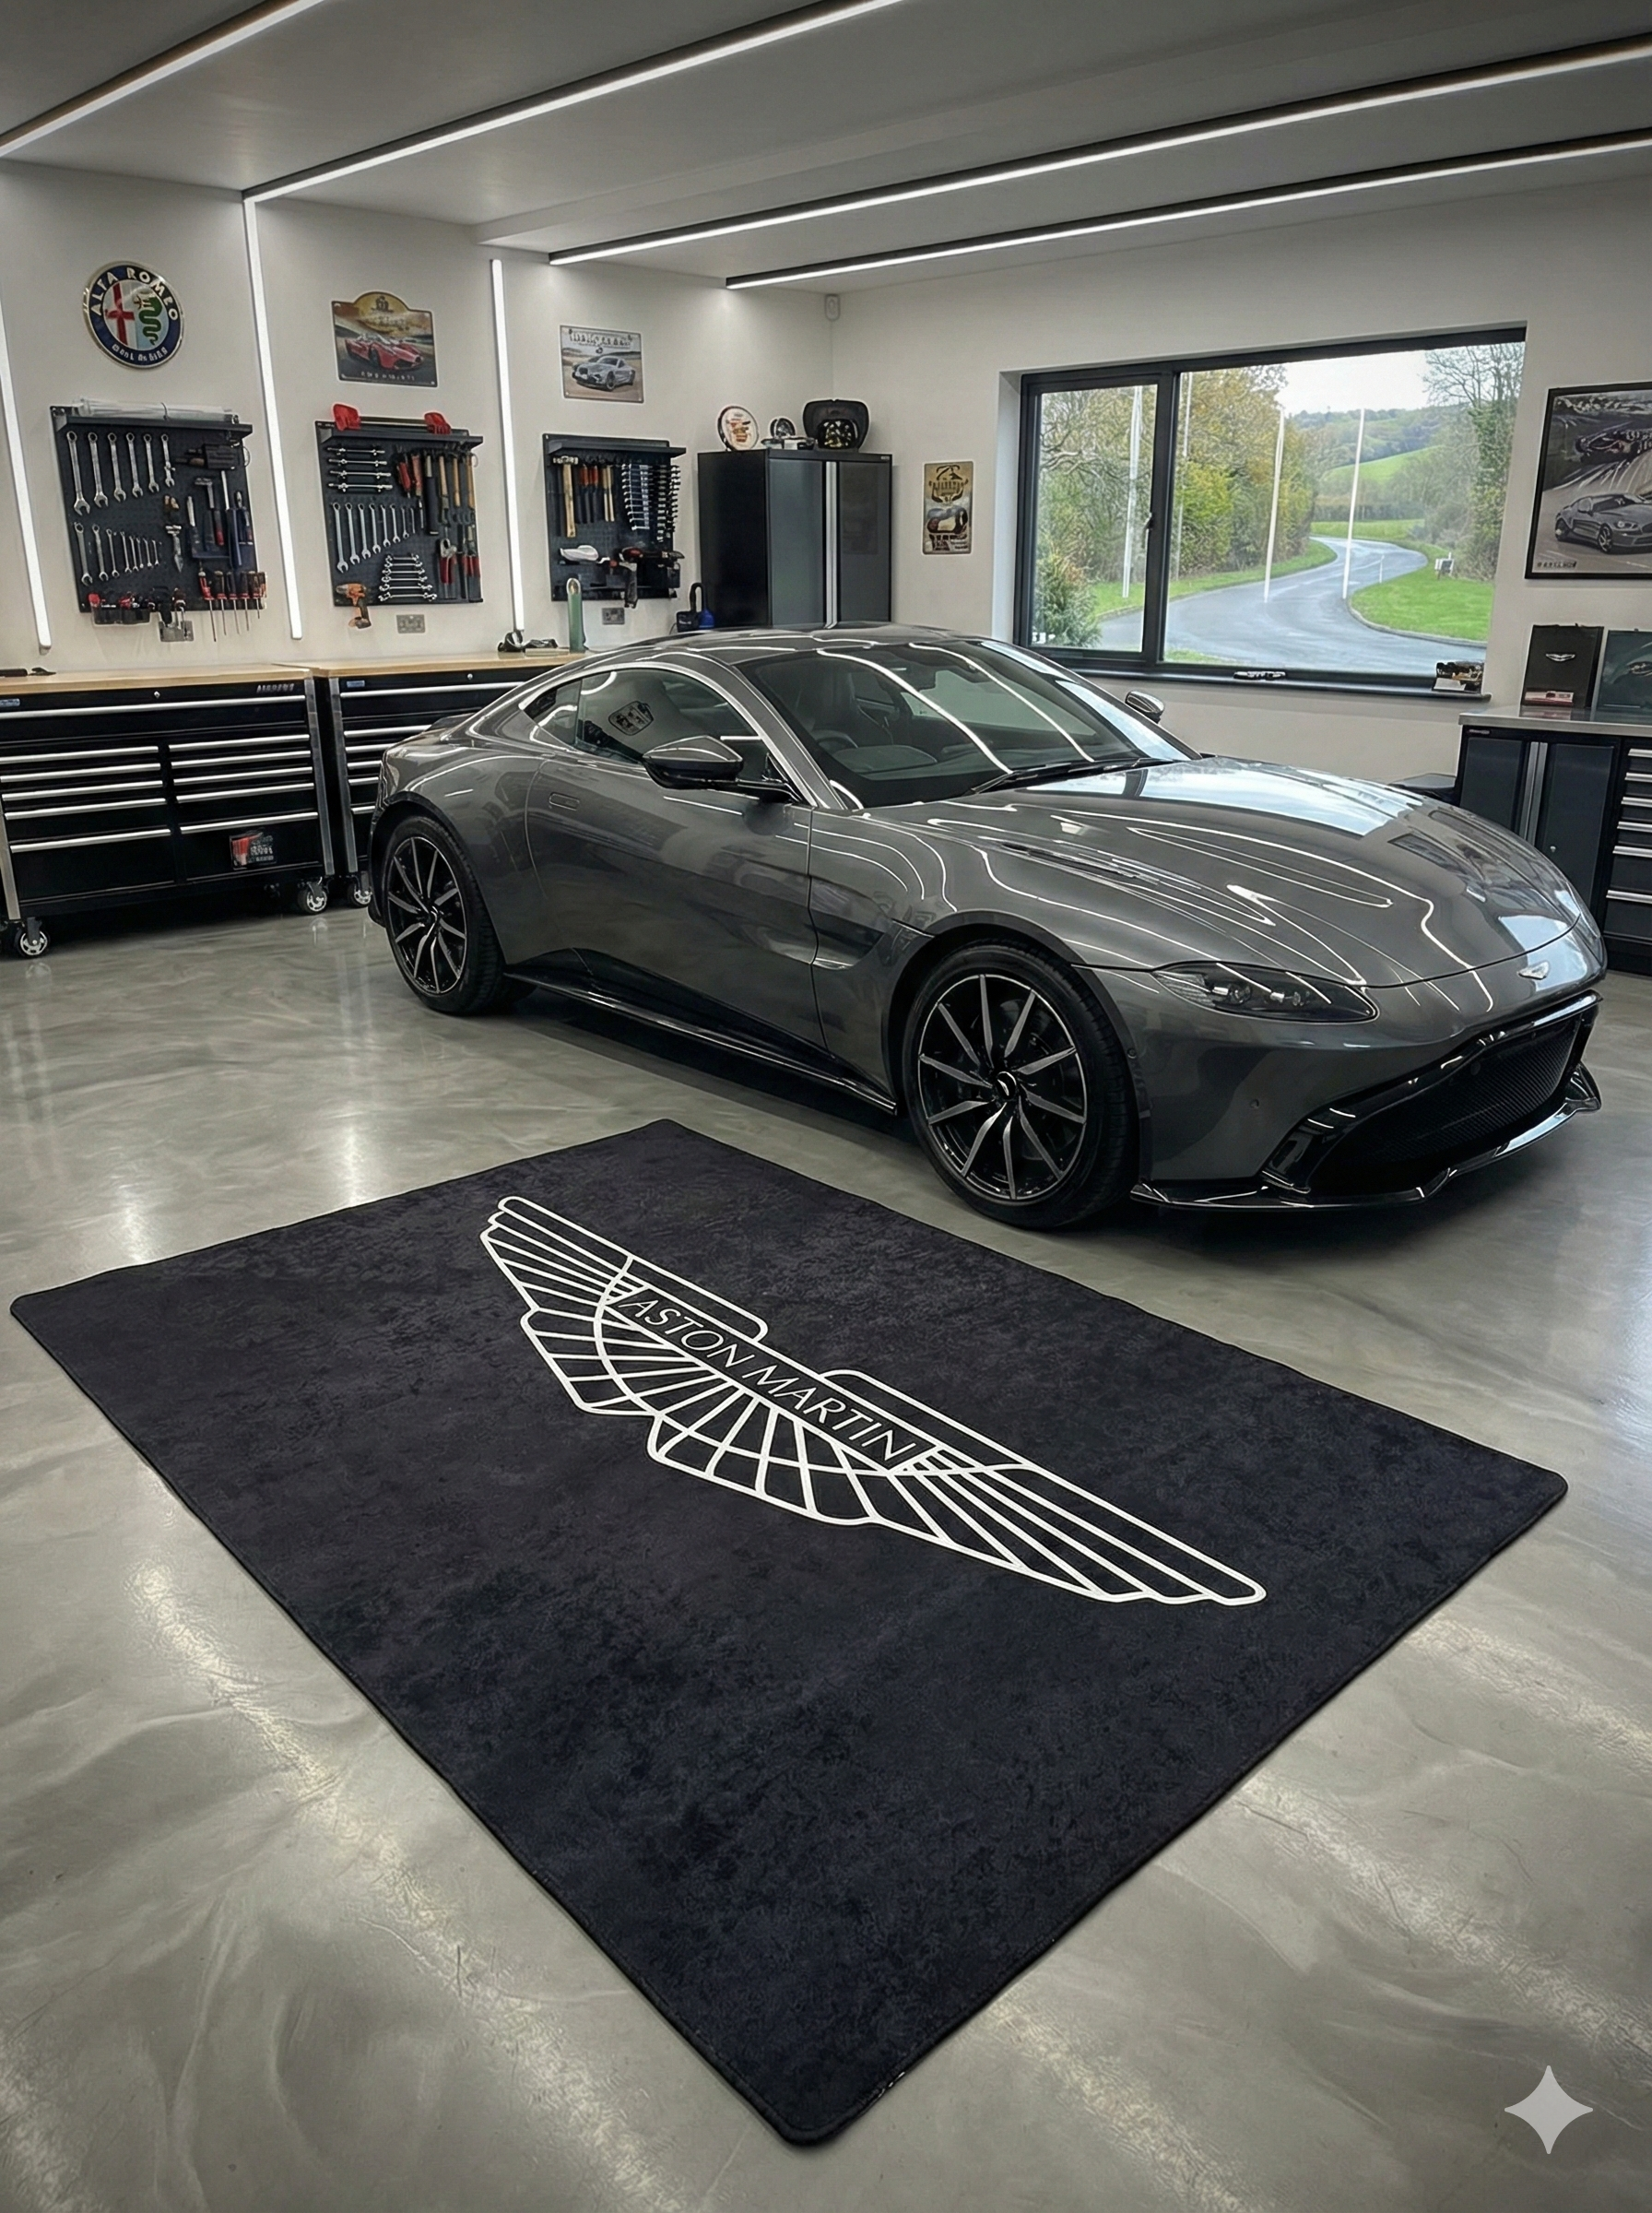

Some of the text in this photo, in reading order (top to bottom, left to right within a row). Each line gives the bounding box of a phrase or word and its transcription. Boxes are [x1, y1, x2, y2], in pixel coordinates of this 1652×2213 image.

[90, 266, 179, 321] ALFA ROMEO
[618, 1299, 917, 1462] ASTON MARTIN
